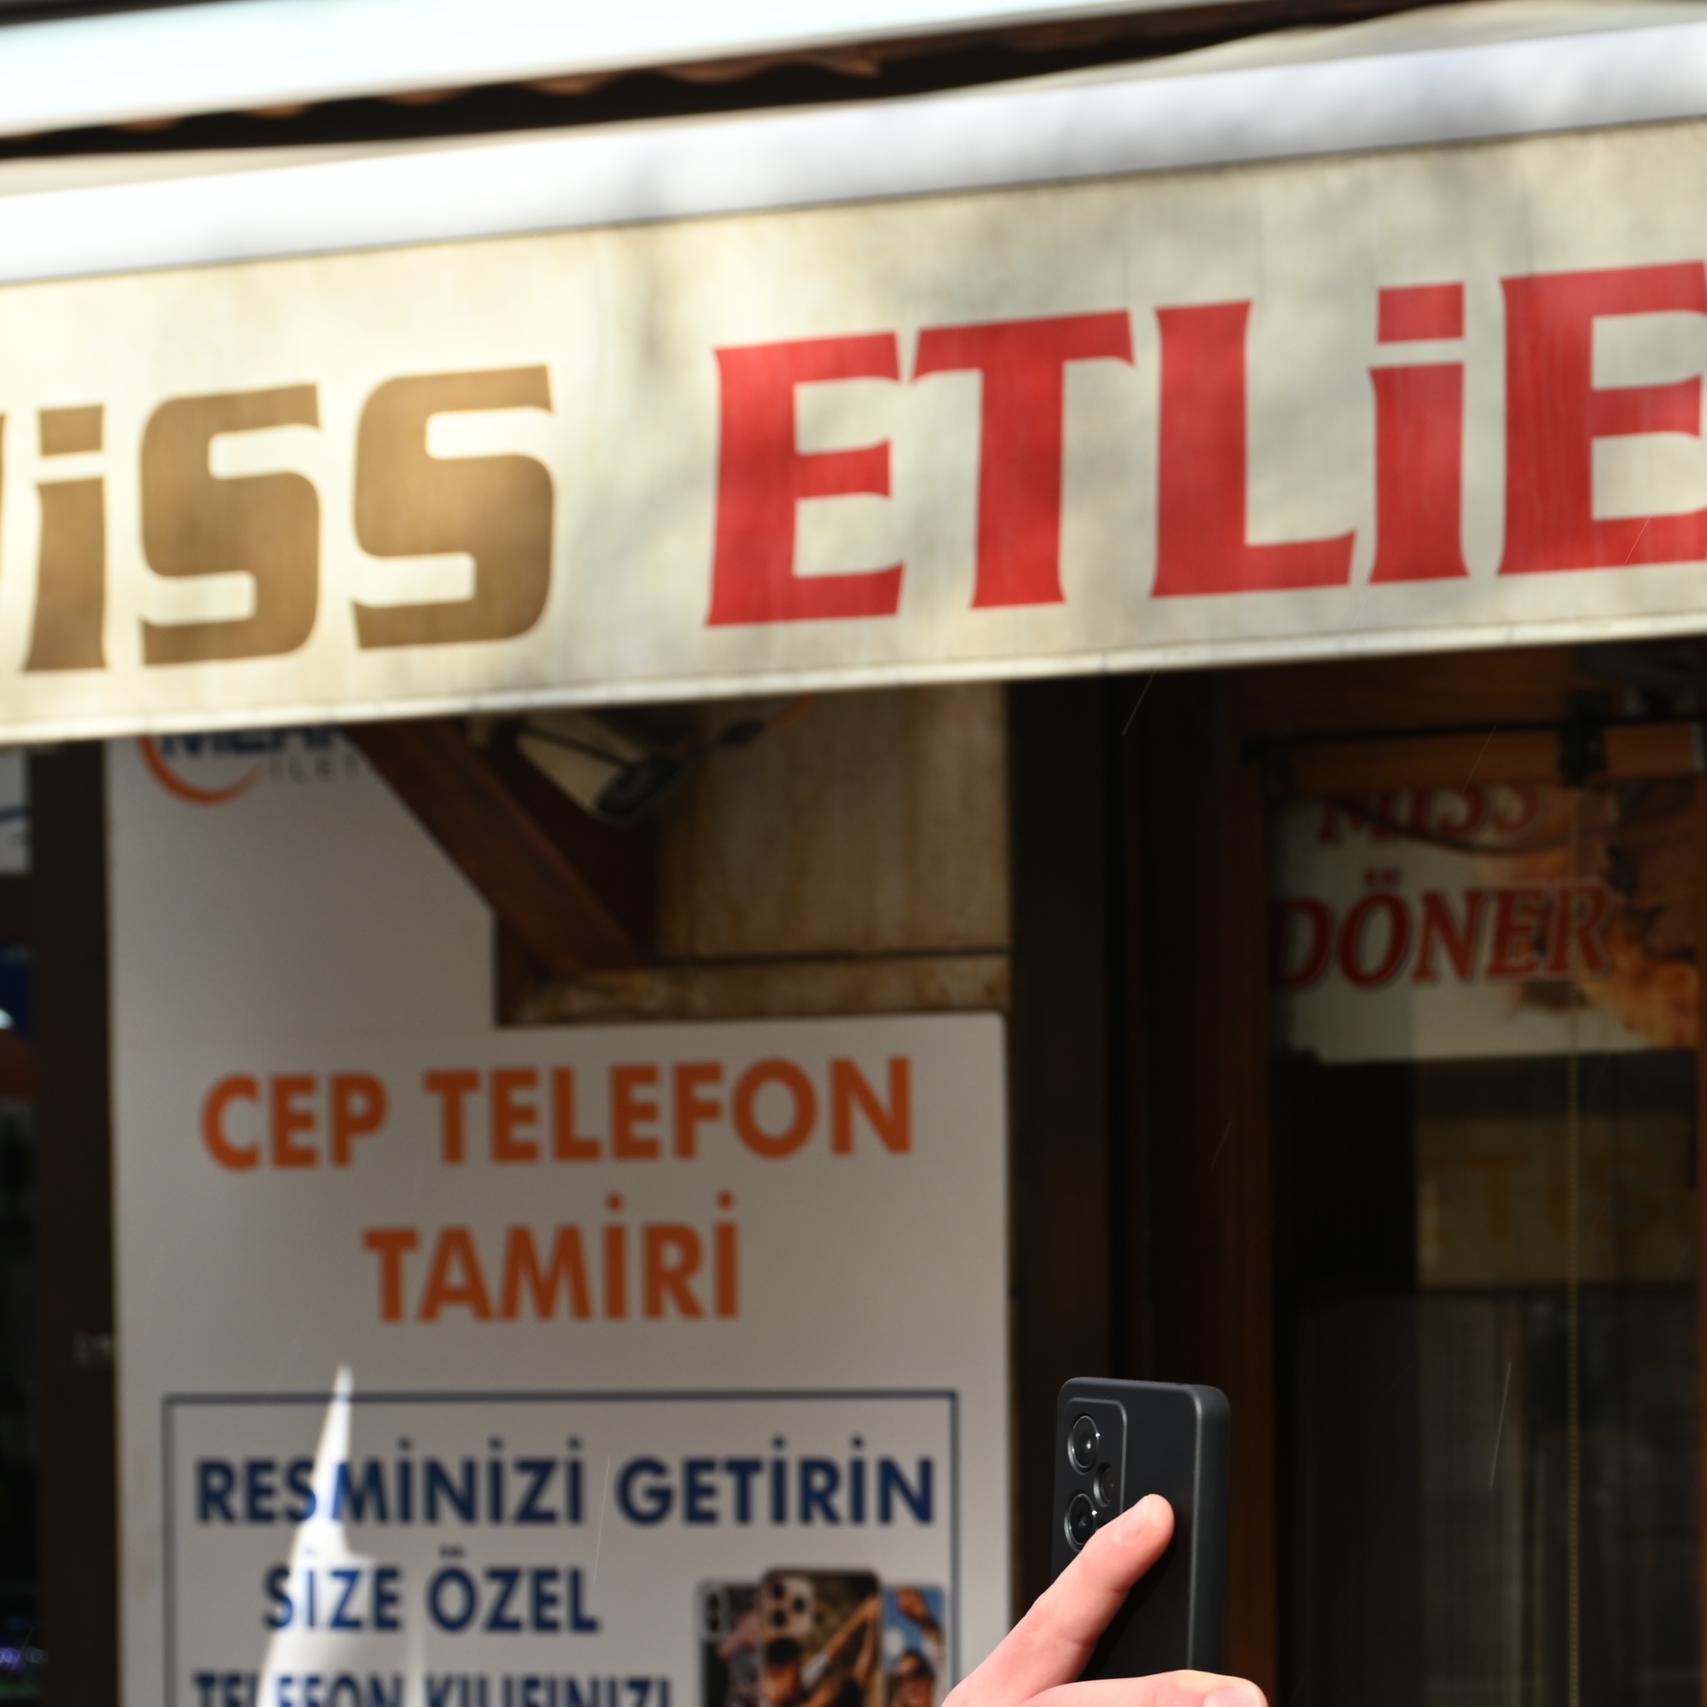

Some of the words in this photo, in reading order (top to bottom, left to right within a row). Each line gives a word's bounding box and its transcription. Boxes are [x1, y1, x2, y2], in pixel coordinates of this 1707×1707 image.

[1271, 865, 1612, 991] DÖNER
[200, 1072, 391, 1173] CEP
[424, 1056, 912, 1163] TELEFON
[363, 1190, 741, 1324] TAMİRİ
[427, 1545, 602, 1634] ÖZEL
